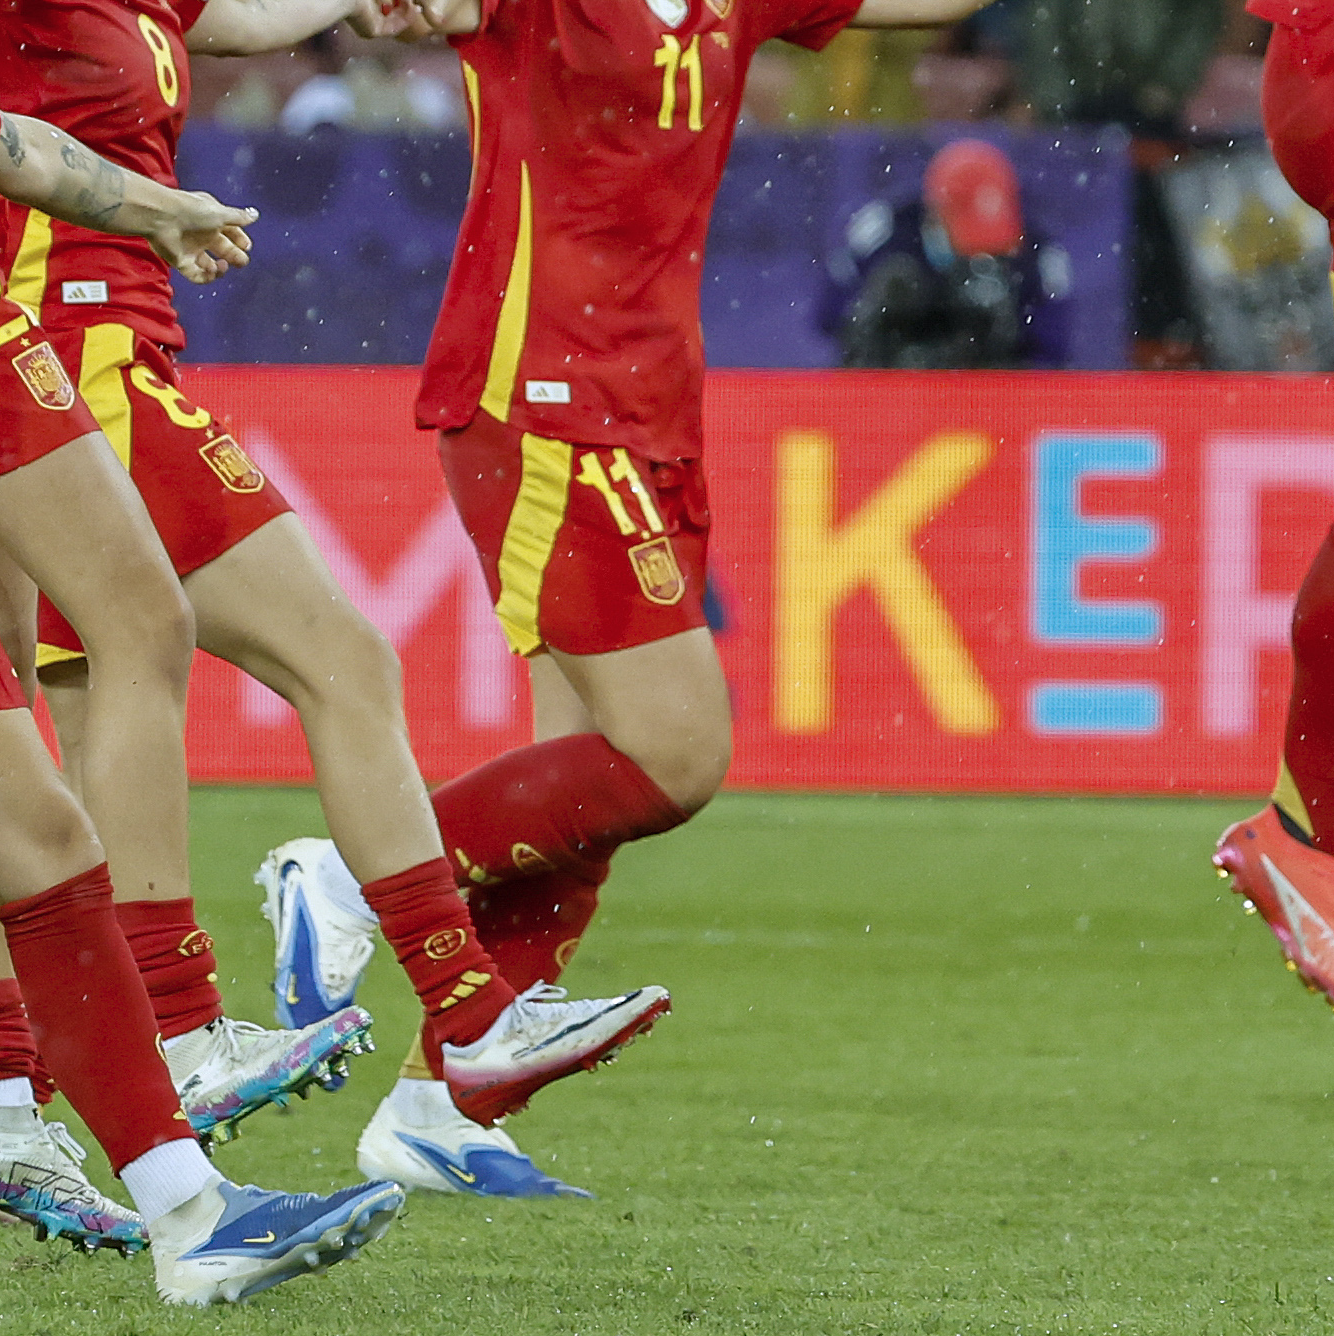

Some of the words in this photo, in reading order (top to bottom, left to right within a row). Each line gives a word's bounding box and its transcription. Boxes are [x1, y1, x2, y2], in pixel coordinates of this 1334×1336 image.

[137, 12, 178, 108] 8
[653, 33, 705, 132] 11
[129, 364, 212, 429] 8
[575, 447, 665, 536] 11
